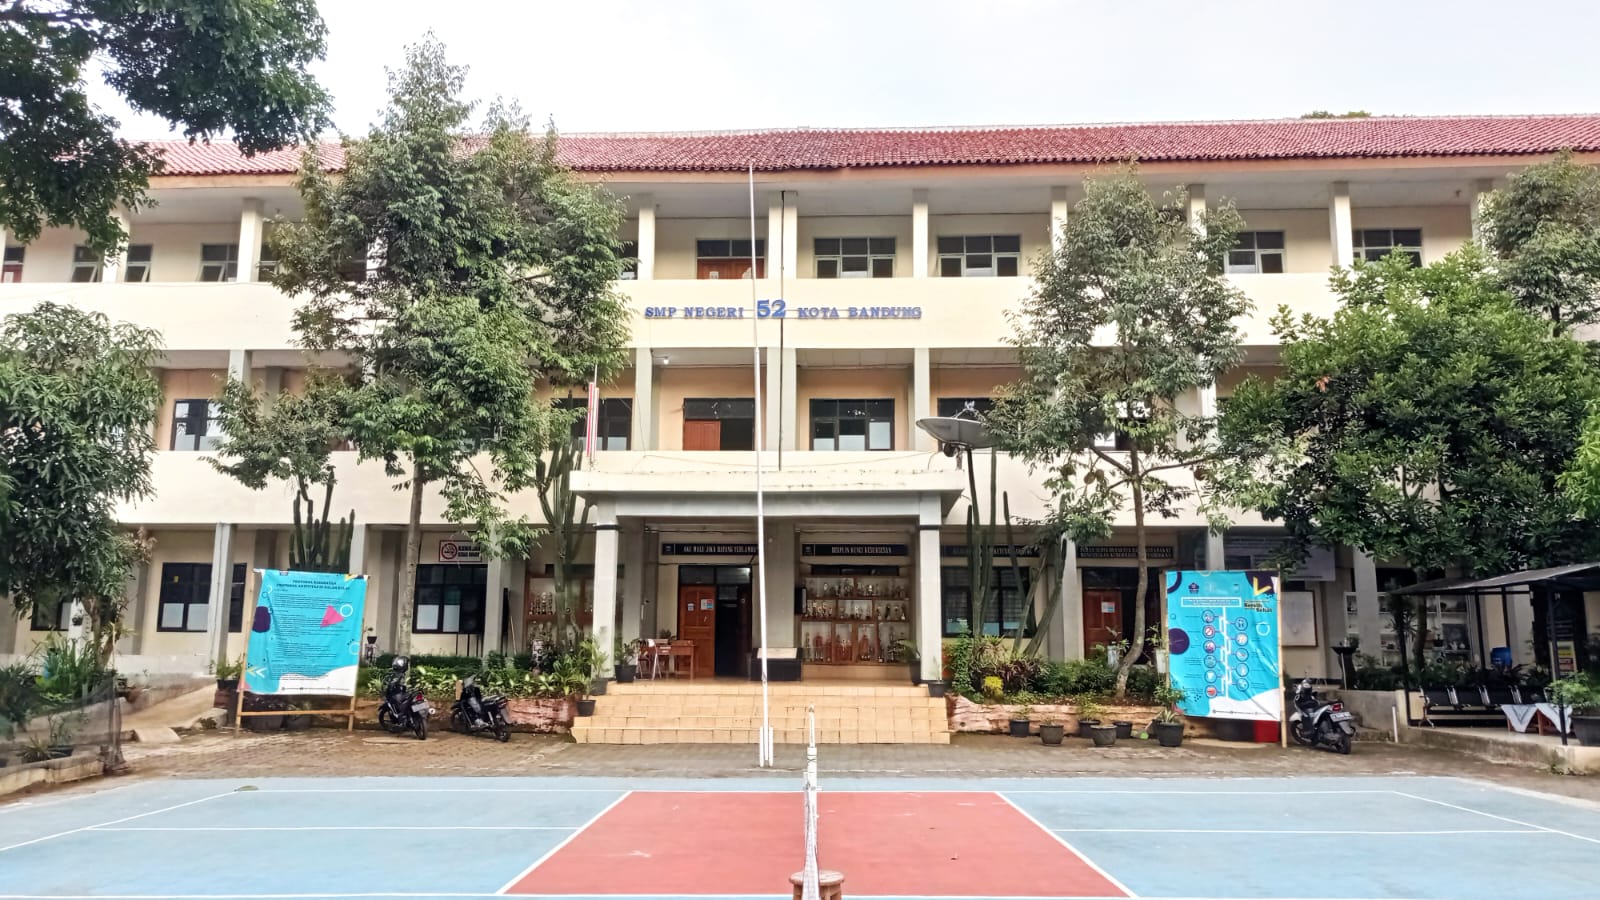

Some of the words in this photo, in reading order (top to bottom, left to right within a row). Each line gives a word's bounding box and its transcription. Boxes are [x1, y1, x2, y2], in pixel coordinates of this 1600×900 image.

[645, 307, 677, 319] SMP
[684, 307, 744, 319] NEGERI
[756, 299, 786, 318] 52
[797, 307, 840, 319] KOTA
[848, 307, 922, 319] BANDUNG
